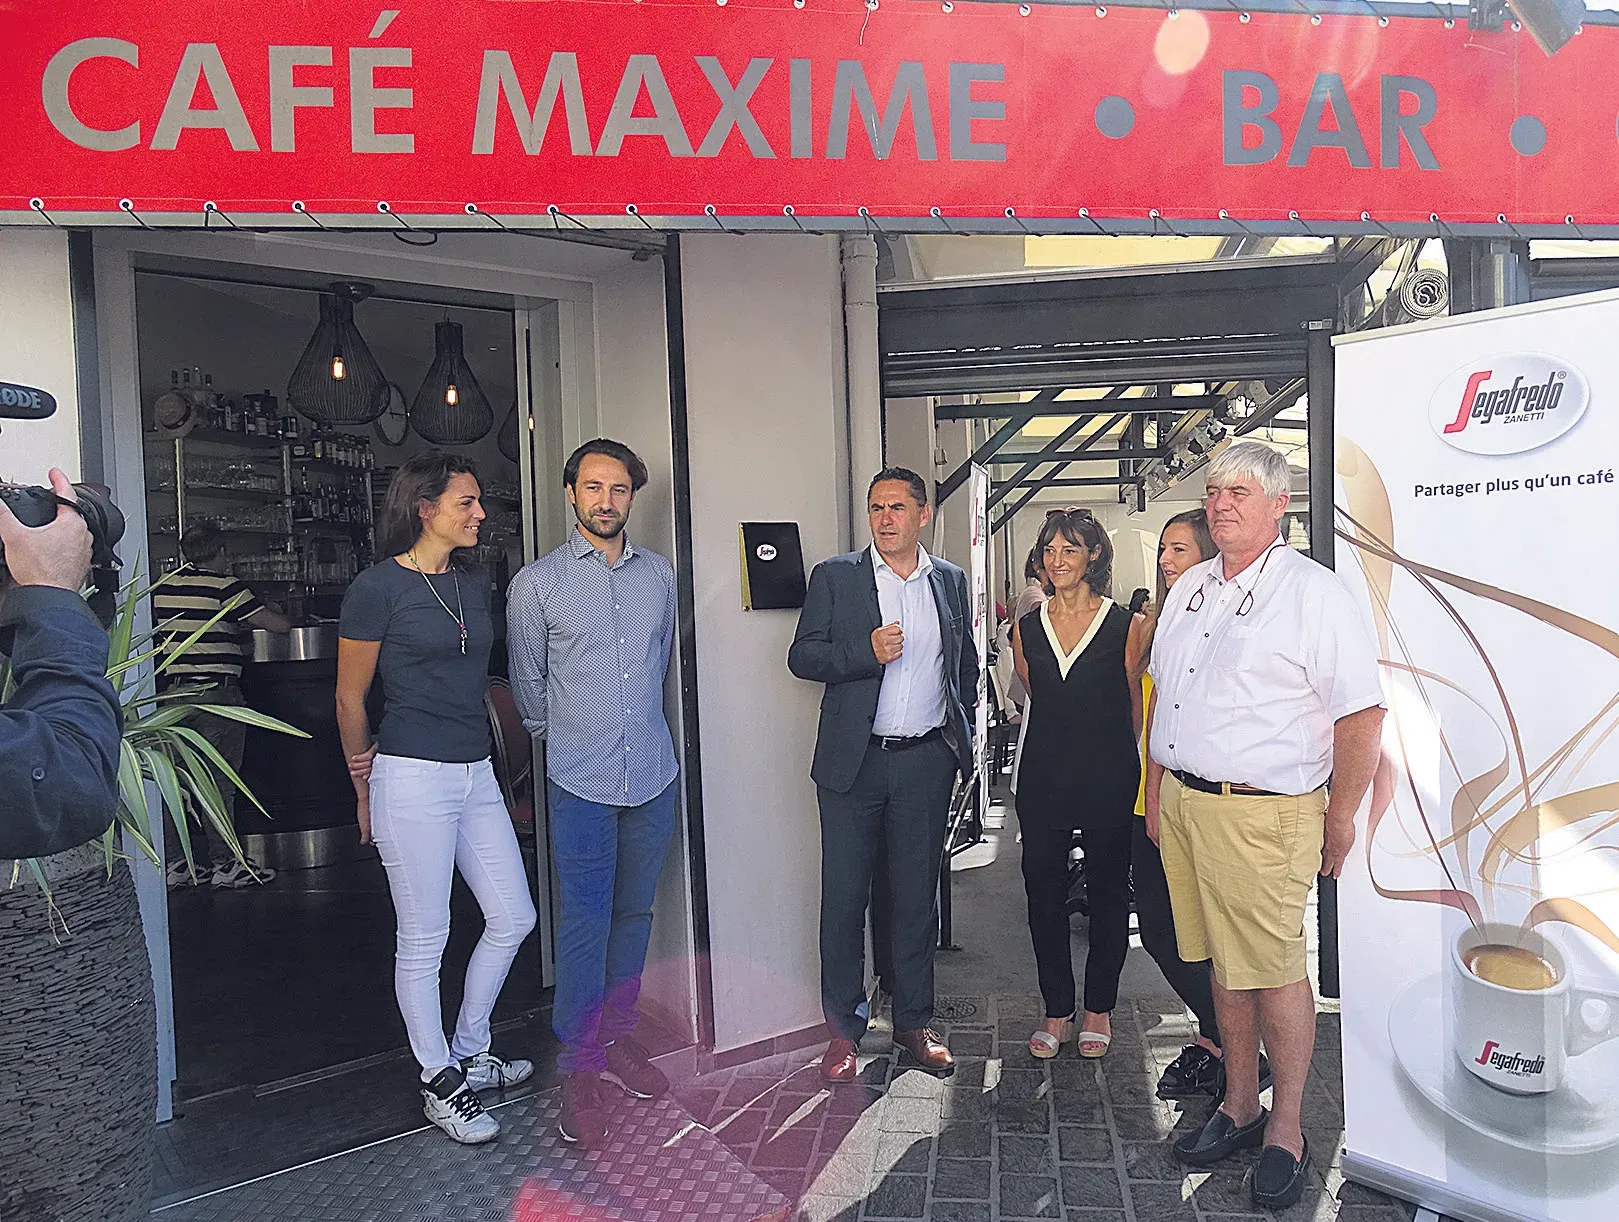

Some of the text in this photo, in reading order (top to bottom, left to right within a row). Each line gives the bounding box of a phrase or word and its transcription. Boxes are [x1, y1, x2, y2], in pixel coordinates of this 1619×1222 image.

[41, 10, 1007, 162] CAFÉ MAXIME
[1221, 70, 1440, 171] BAR
[0, 388, 41, 409] ØDE
[1443, 370, 1564, 434] Segafredo
[1503, 411, 1545, 424] ZANETTI
[1414, 482, 1481, 498] Partager
[1486, 478, 1519, 494] plus
[1577, 468, 1614, 485] café
[1474, 1040, 1545, 1074] Segafredo
